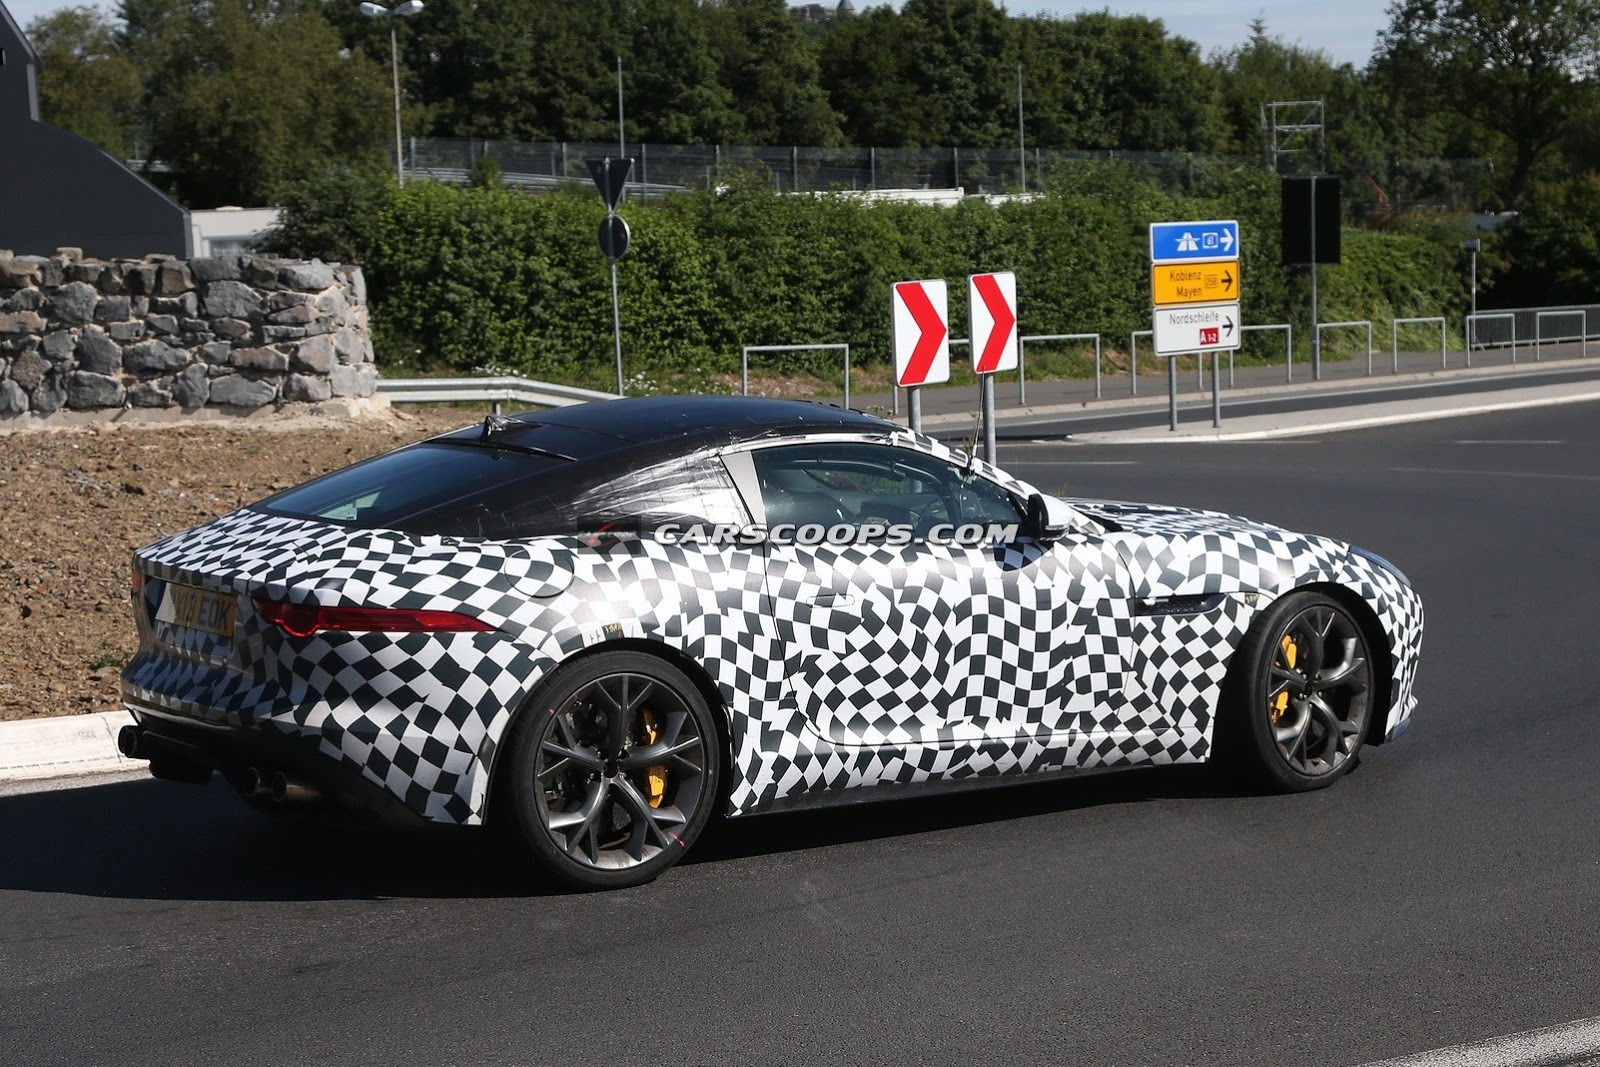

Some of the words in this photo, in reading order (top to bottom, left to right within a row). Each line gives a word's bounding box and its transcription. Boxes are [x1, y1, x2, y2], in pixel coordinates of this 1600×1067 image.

[1169, 269, 1202, 282] Koblenz
[1176, 285, 1203, 299] Mayen
[1169, 311, 1220, 325] Nordschleife
[1201, 330, 1207, 343] A
